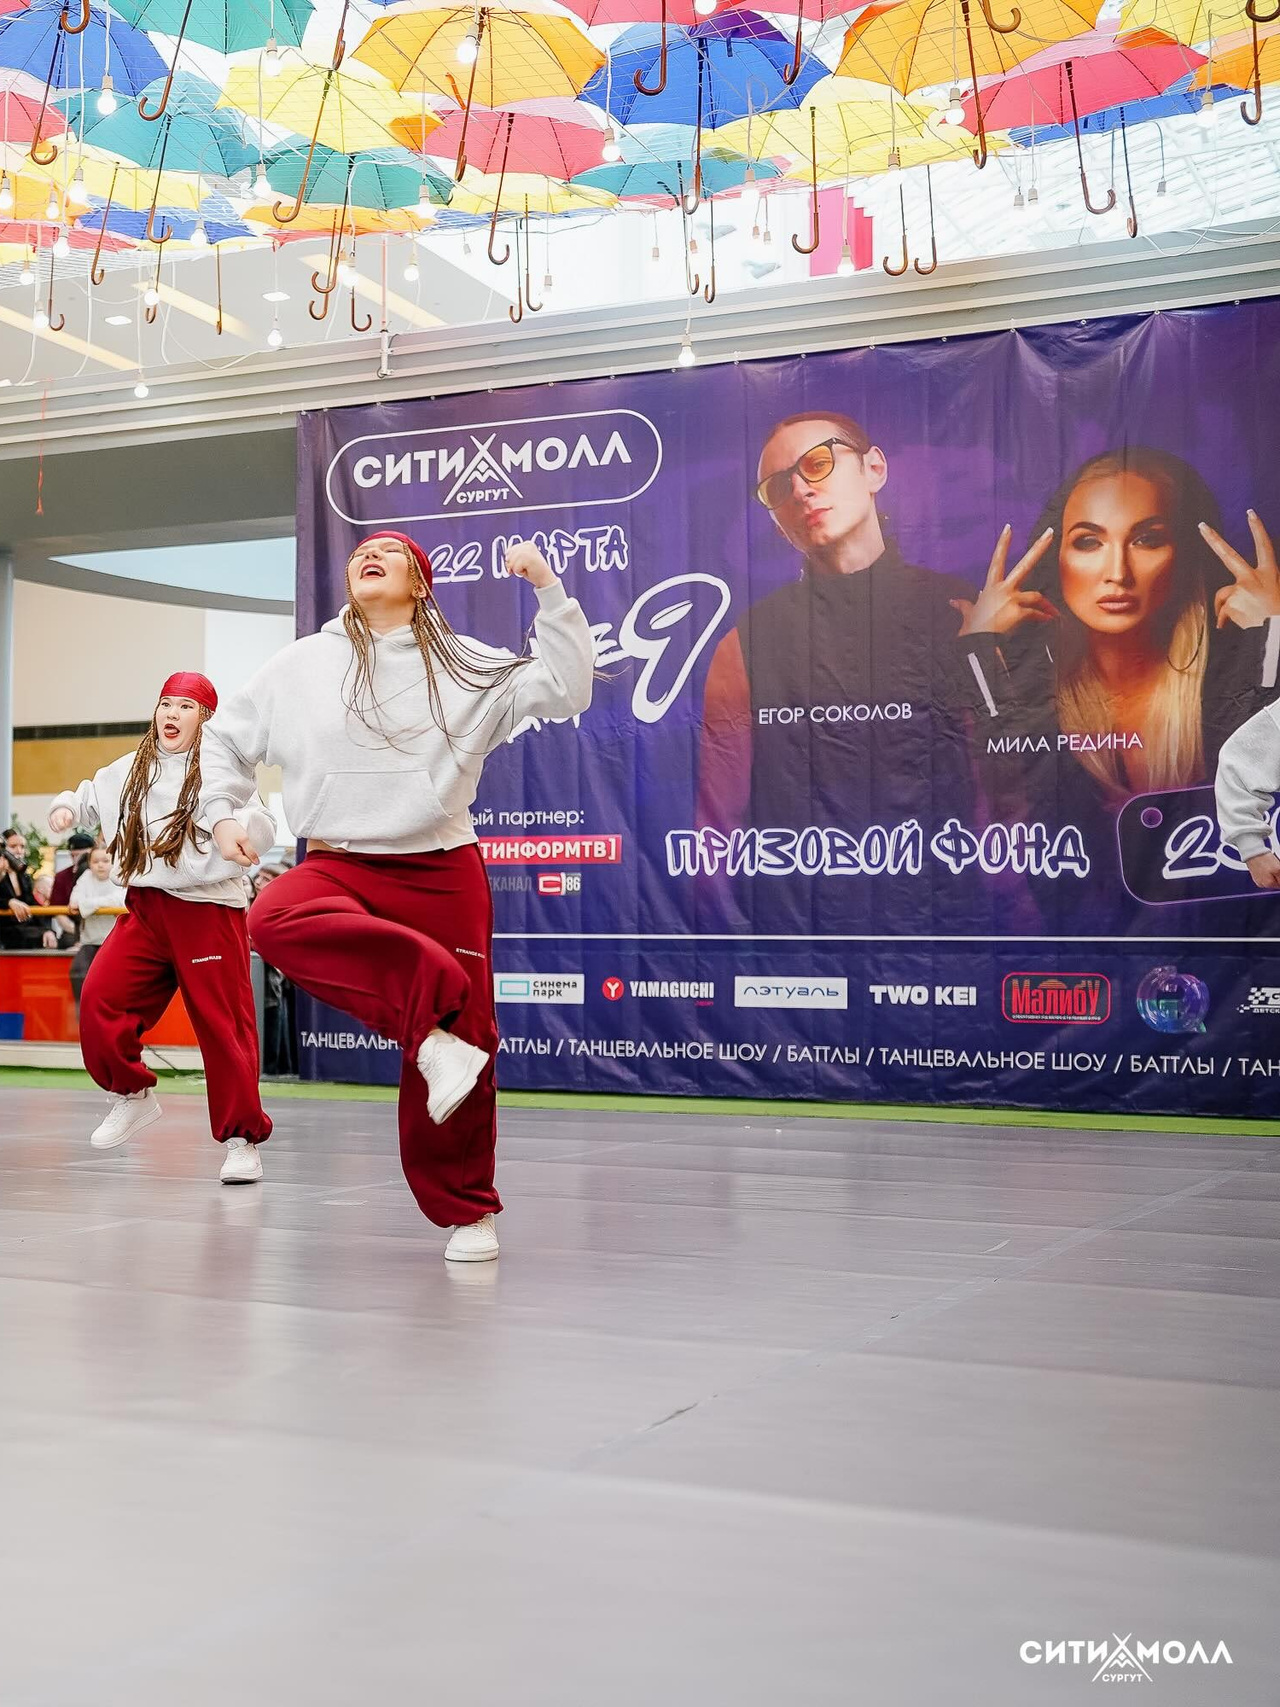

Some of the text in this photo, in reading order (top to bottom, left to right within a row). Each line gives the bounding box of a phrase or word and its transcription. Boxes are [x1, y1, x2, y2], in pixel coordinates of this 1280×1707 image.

[352, 430, 632, 488] СИТИ МОЛЛ
[456, 487, 510, 504] СУРГУТ
[758, 702, 913, 725] ЕГОР СОКОЛОВ
[986, 732, 1144, 754] МИЛА РЕДИНА
[498, 809, 585, 829] партнер:
[478, 837, 617, 861] ТИНФОРМТВ]
[664, 818, 923, 877] ПРИЗОВОЙ
[929, 817, 1091, 879] ФОНД
[629, 980, 715, 999] YAMAGUCHI
[869, 984, 977, 1006] TWO KEI
[300, 1030, 405, 1050] ТАНЦЕВАЛЬН
[497, 1037, 551, 1056] АТТЛЫ
[568, 1038, 714, 1060] ТАНЦЕВАЛЬНОЕ
[719, 1043, 768, 1062] ШОУ
[787, 1044, 860, 1064] БАТТЛЫ
[879, 1047, 1045, 1070] ТАНЦЕВАЛЬНОЕ
[1051, 1051, 1107, 1072] ШОУ
[1130, 1054, 1214, 1075] БАТТЛЫ
